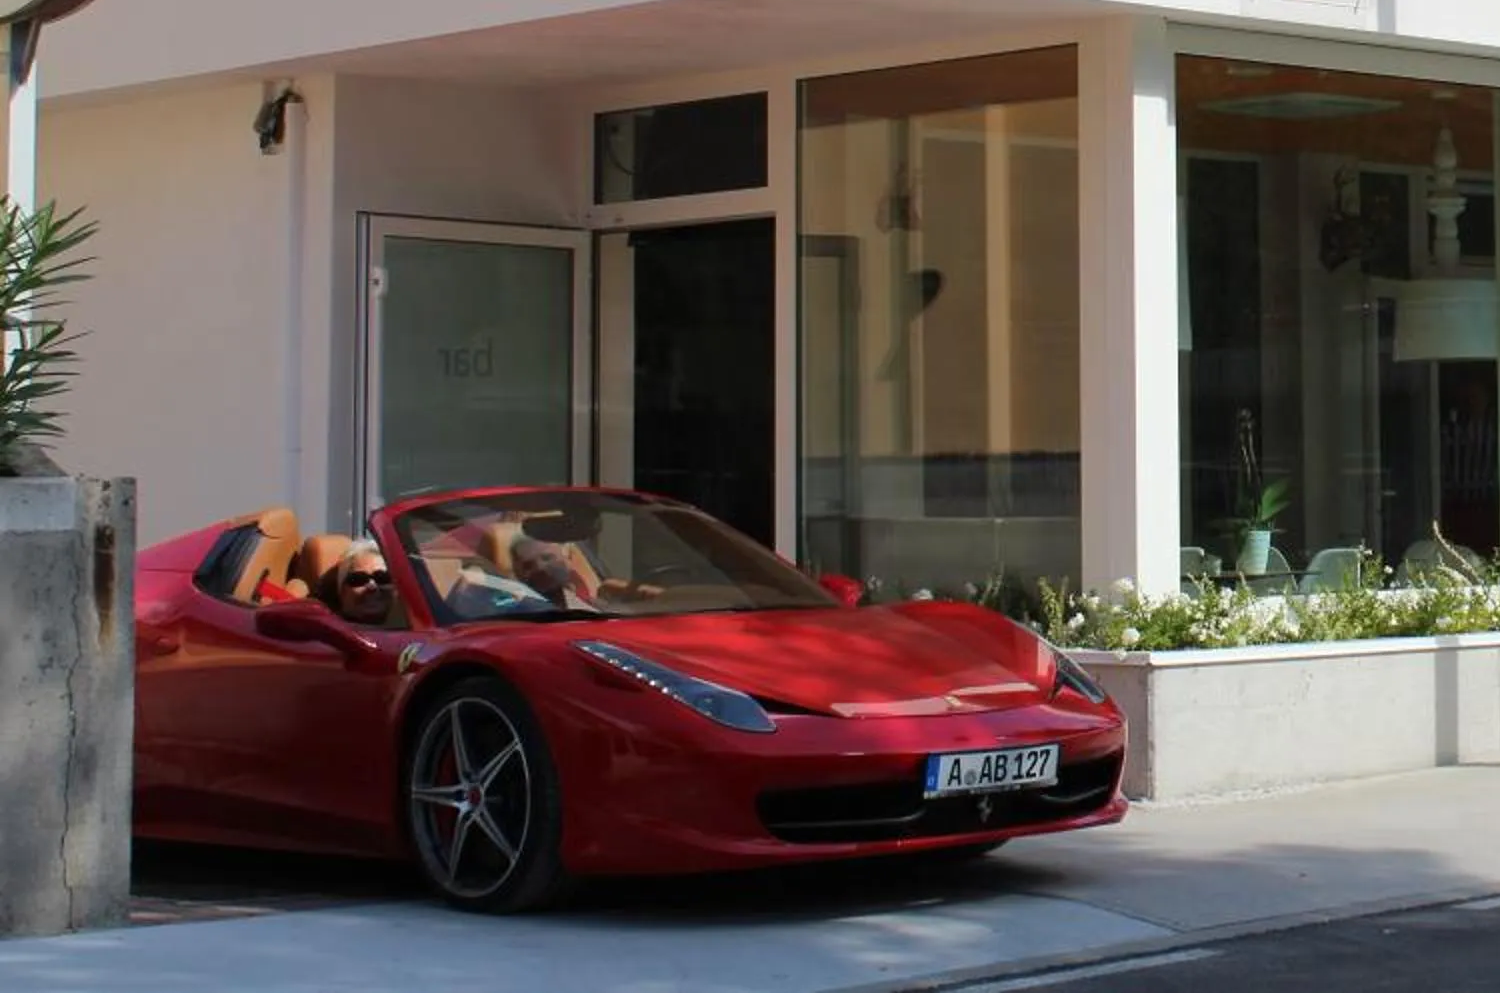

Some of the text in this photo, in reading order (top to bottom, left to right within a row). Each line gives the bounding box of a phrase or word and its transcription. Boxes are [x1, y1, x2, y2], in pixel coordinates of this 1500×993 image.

[947, 748, 1051, 787] A AB 127
